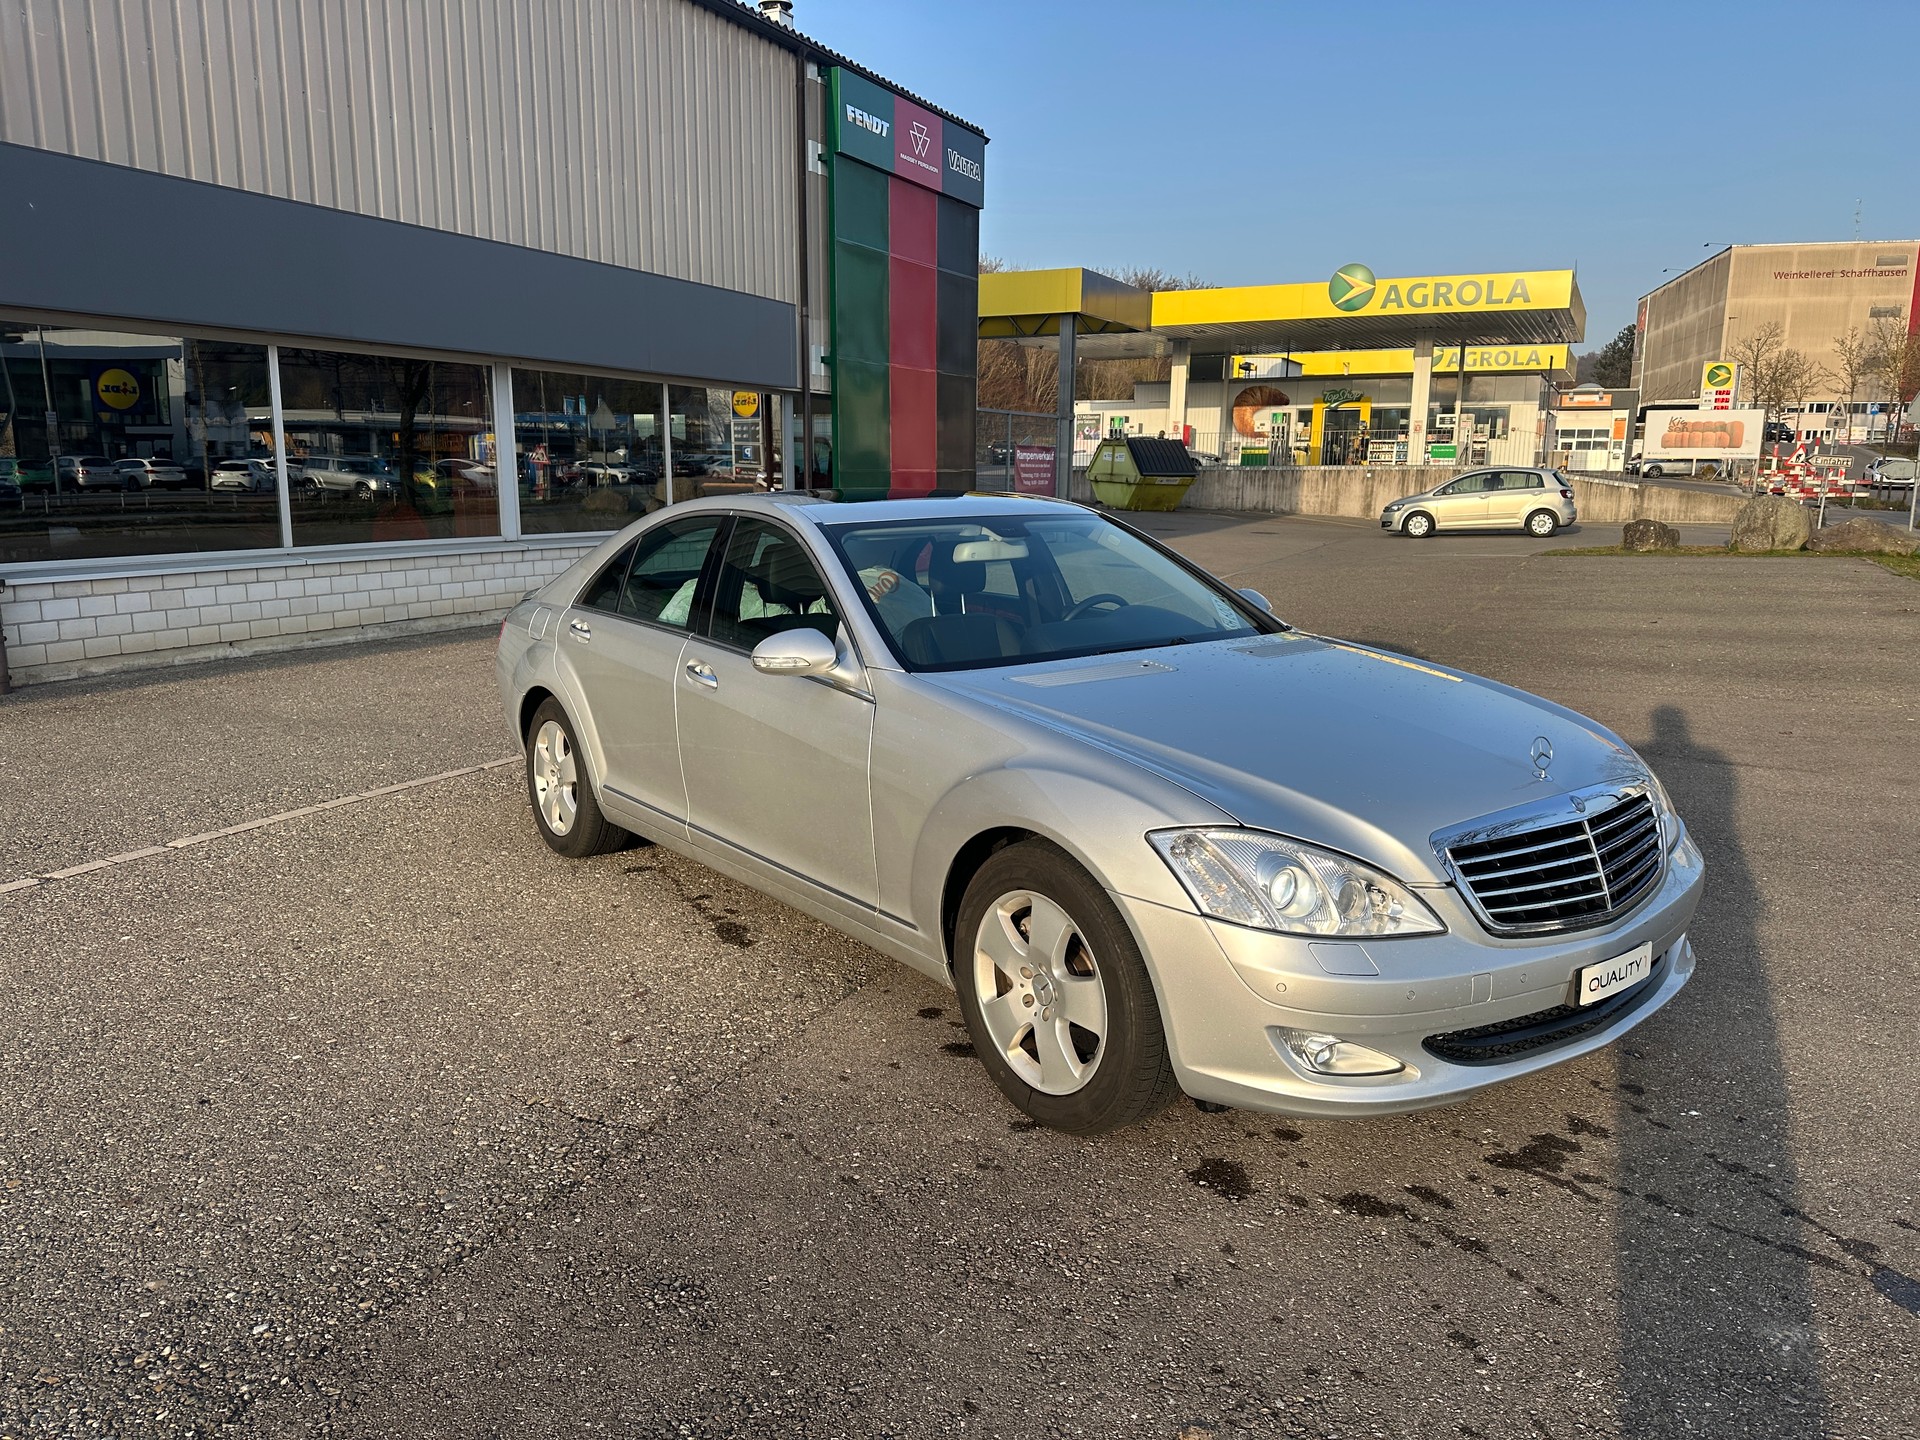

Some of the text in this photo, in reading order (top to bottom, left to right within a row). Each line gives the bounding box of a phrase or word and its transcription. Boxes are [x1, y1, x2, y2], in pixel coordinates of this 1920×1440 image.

[845, 104, 890, 138] FENDT
[947, 148, 981, 182] VALTRA
[1773, 268, 1908, 280] Weinkellerei Schaffhausen
[1379, 278, 1532, 310] AGROLA
[1445, 349, 1542, 368] AGROLA
[1016, 449, 1055, 462] Rampenverkauf
[1815, 456, 1850, 466] Einfahrt
